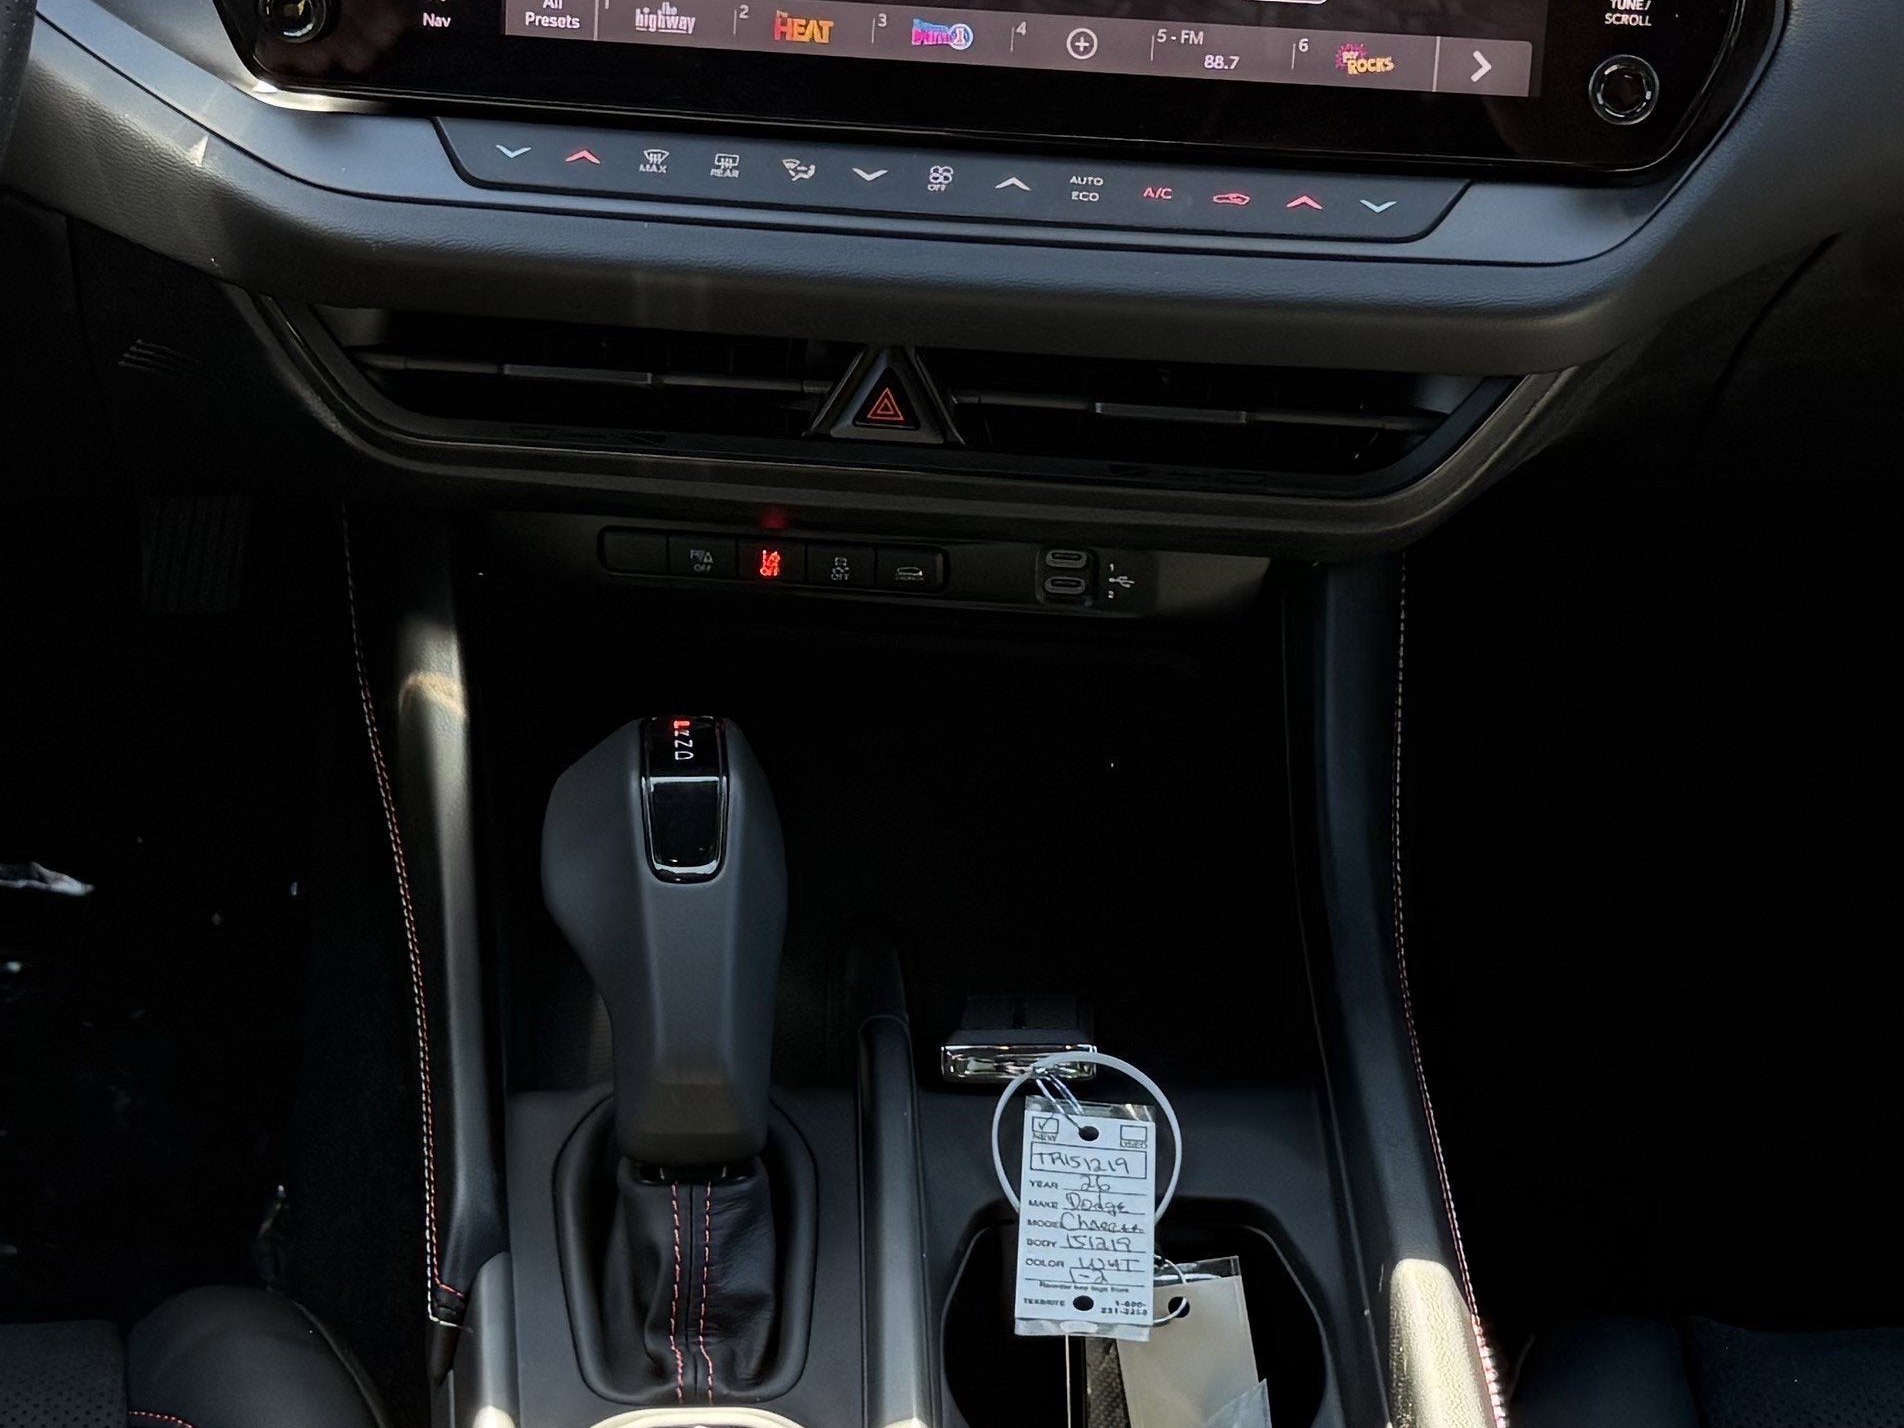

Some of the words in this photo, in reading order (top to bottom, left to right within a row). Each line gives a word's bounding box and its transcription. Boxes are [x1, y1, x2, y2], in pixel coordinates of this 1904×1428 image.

[739, 4, 749, 19] 2
[422, 12, 452, 28] Nav
[524, 9, 581, 29] Presets
[635, 6, 696, 34] highway
[877, 13, 887, 27] 3
[1604, 12, 1652, 27] SCROLL
[774, 12, 834, 43] HEAT
[1016, 21, 1027, 36] 4
[1157, 29, 1167, 43] 5
[1180, 30, 1205, 45] FM
[1298, 38, 1309, 52] 6
[1204, 54, 1240, 70] 88.7
[1348, 56, 1395, 75] ROCKS
[639, 163, 667, 174] MAX
[710, 168, 739, 178] REAR
[1069, 175, 1104, 186] AUTO
[1071, 191, 1099, 202] ECO
[1142, 186, 1173, 200] A/C
[1028, 1200, 1059, 1209] MAKE
[1026, 1238, 1057, 1248] BODY
[1025, 1259, 1065, 1268] COLOR
